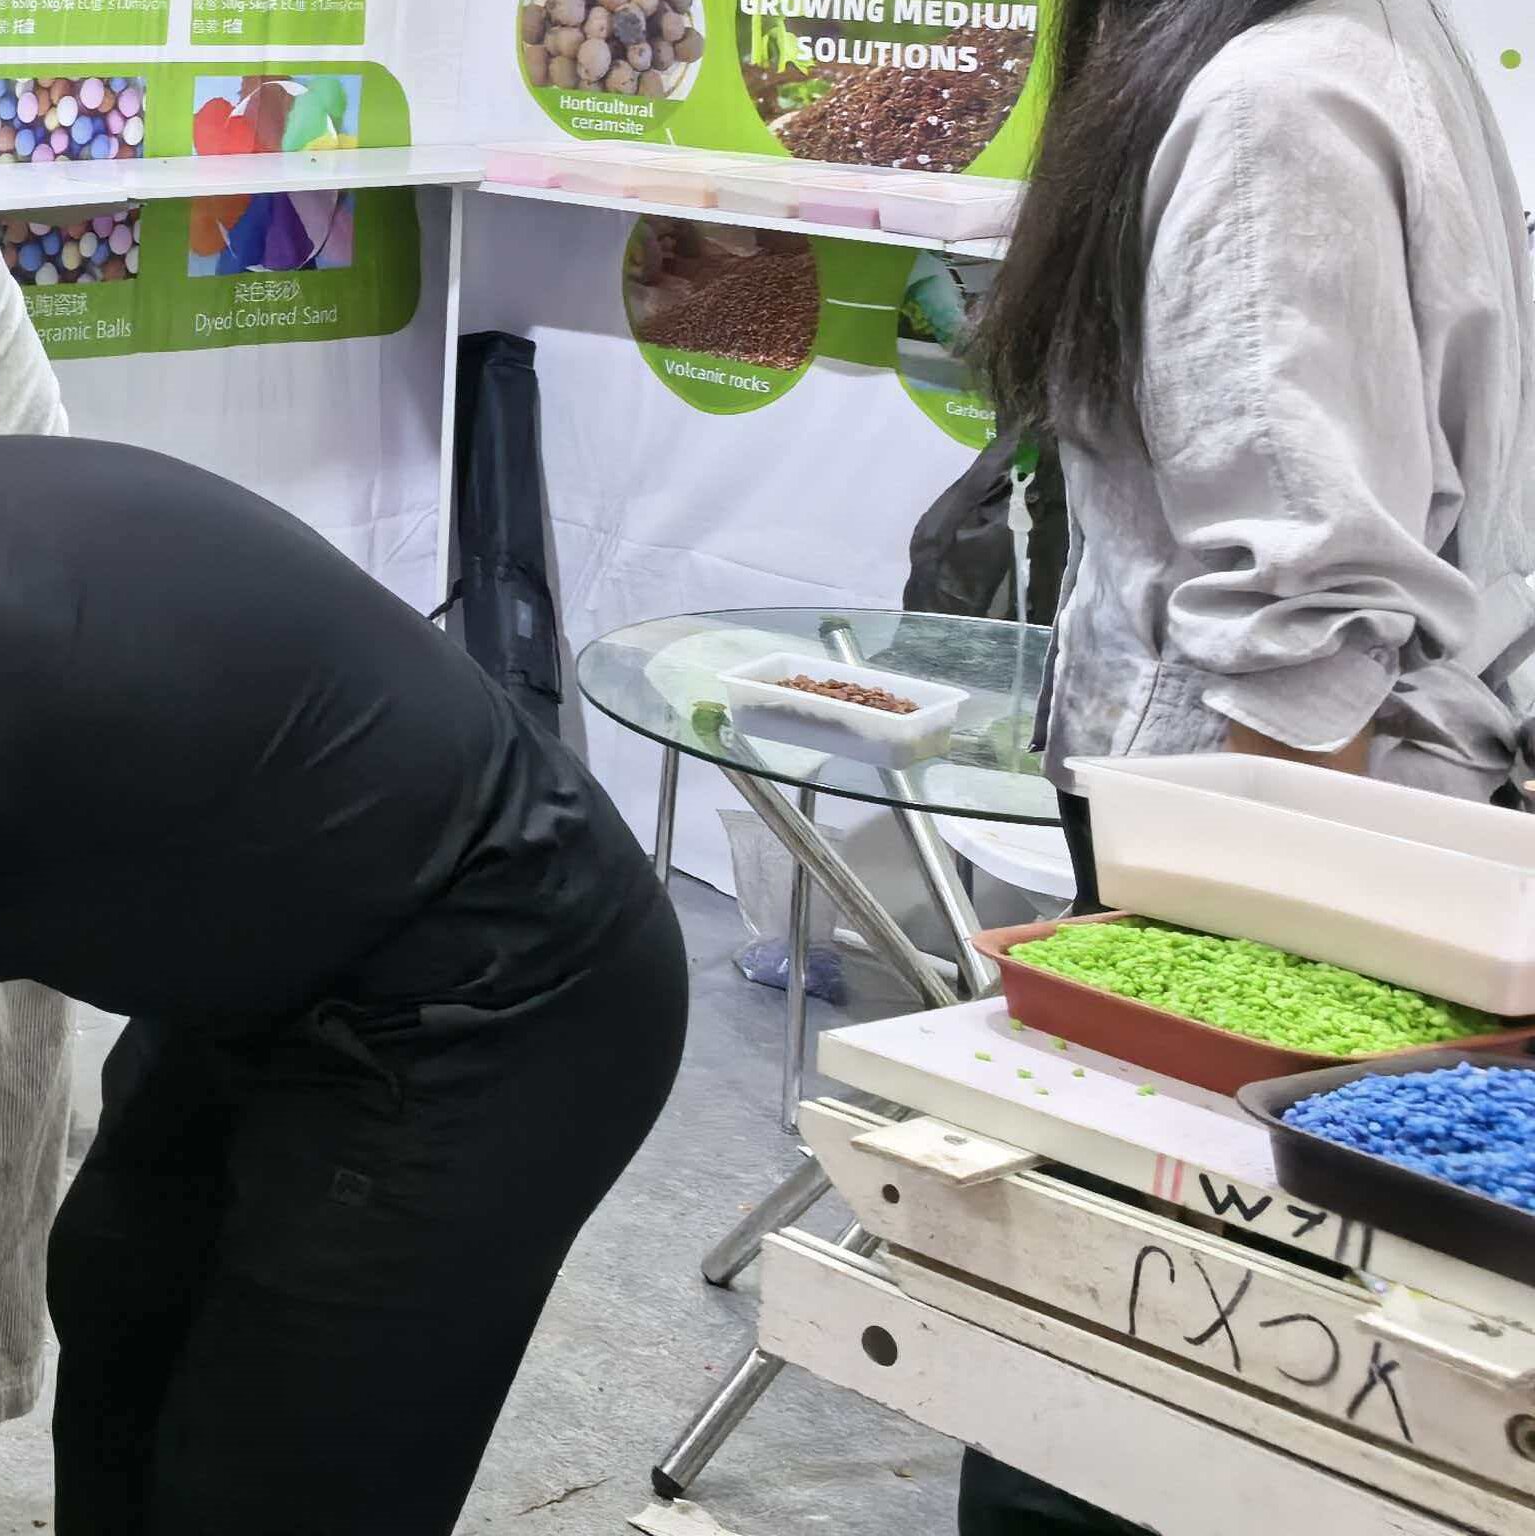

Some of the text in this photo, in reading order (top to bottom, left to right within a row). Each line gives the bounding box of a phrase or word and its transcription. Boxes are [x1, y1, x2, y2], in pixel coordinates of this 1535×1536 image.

[796, 35, 979, 73] SOLUTIONS
[559, 95, 654, 119] Horticultural
[571, 115, 644, 136] ceramsite
[39, 319, 132, 344] eramic Balls
[194, 305, 338, 337] Dyed Colored Sand
[664, 359, 770, 394] Volcanic rocks
